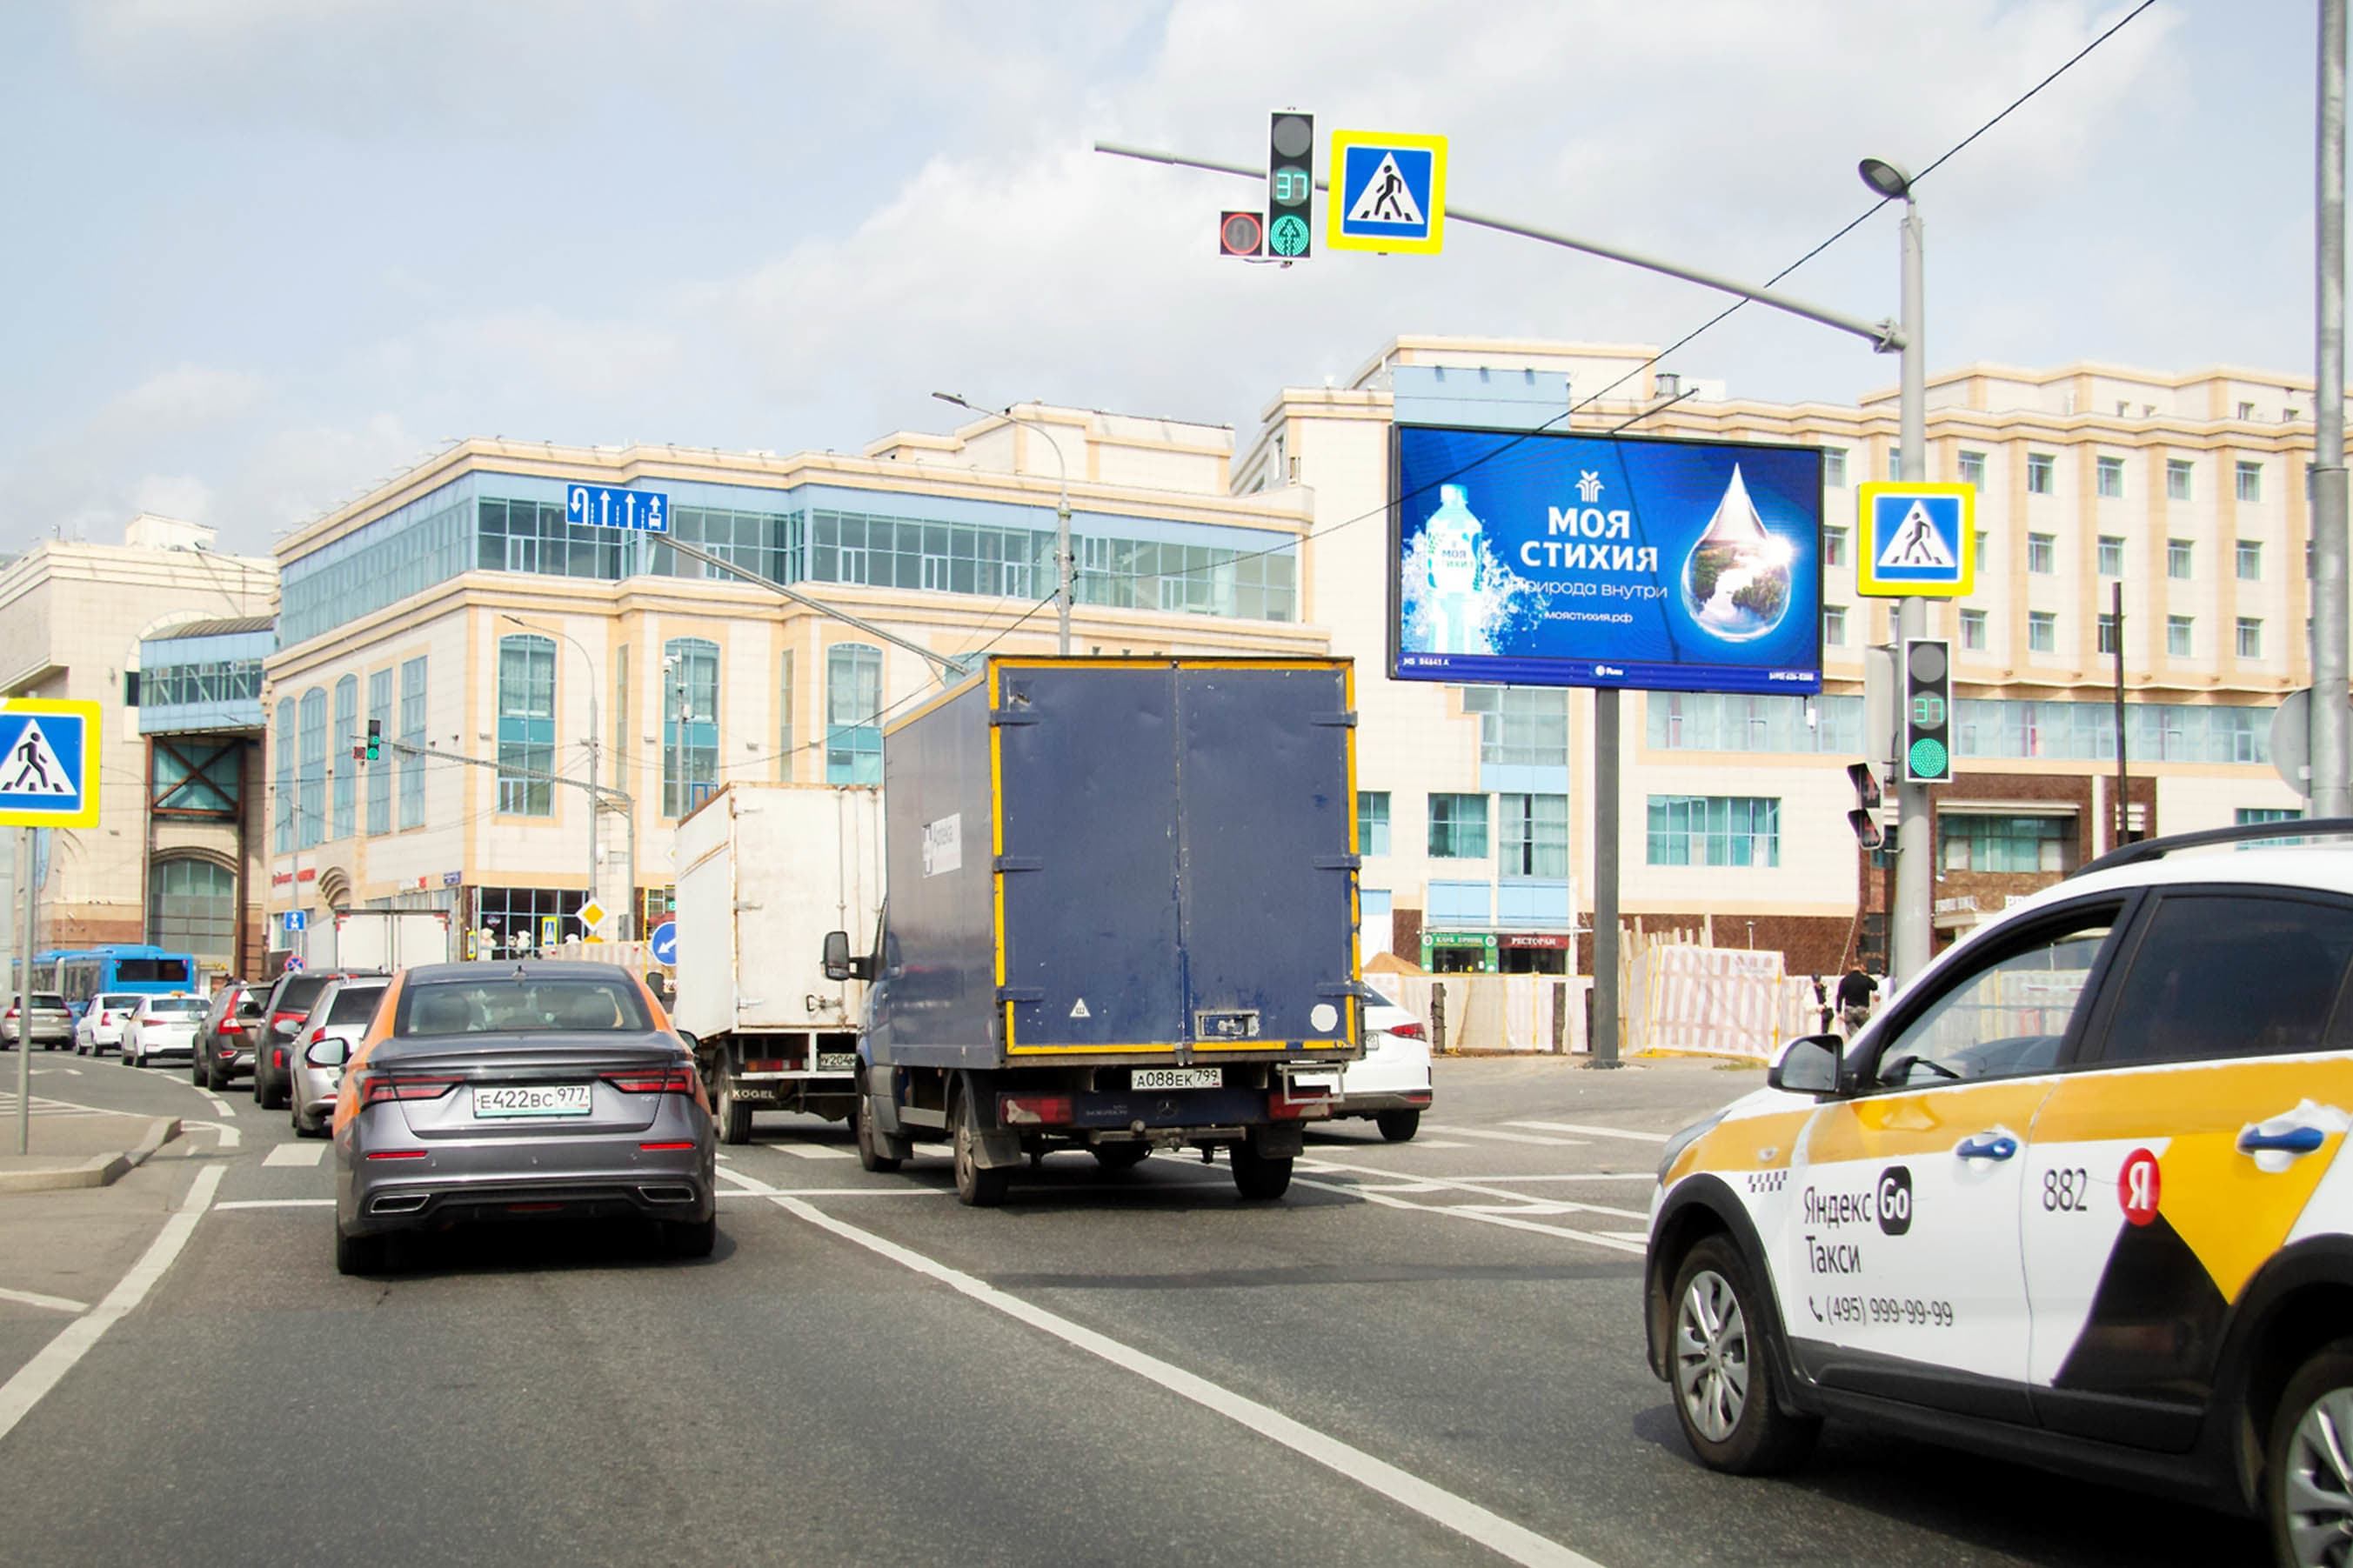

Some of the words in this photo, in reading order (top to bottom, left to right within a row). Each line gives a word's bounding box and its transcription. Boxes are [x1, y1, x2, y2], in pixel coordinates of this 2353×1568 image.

[1277, 173, 1307, 199] 37
[1547, 506, 1630, 538] МОЯ
[1520, 541, 1658, 572] СТИХИЯ
[1601, 584, 1668, 600] внутри
[1914, 697, 1944, 723] 37
[1136, 1071, 1193, 1087] А088ЕК
[1196, 1070, 1219, 1082] 799
[480, 1090, 553, 1109] Е422ВС
[557, 1087, 585, 1101] 977
[2043, 1168, 2088, 1211] 882
[2128, 1160, 2151, 1210] Я
[1804, 1185, 1871, 1229] Яндекс
[1880, 1178, 1909, 1219] Go
[1805, 1236, 1862, 1273] Такси
[1827, 1295, 1867, 1326] (495)
[1869, 1297, 1953, 1327] 999-99-99
